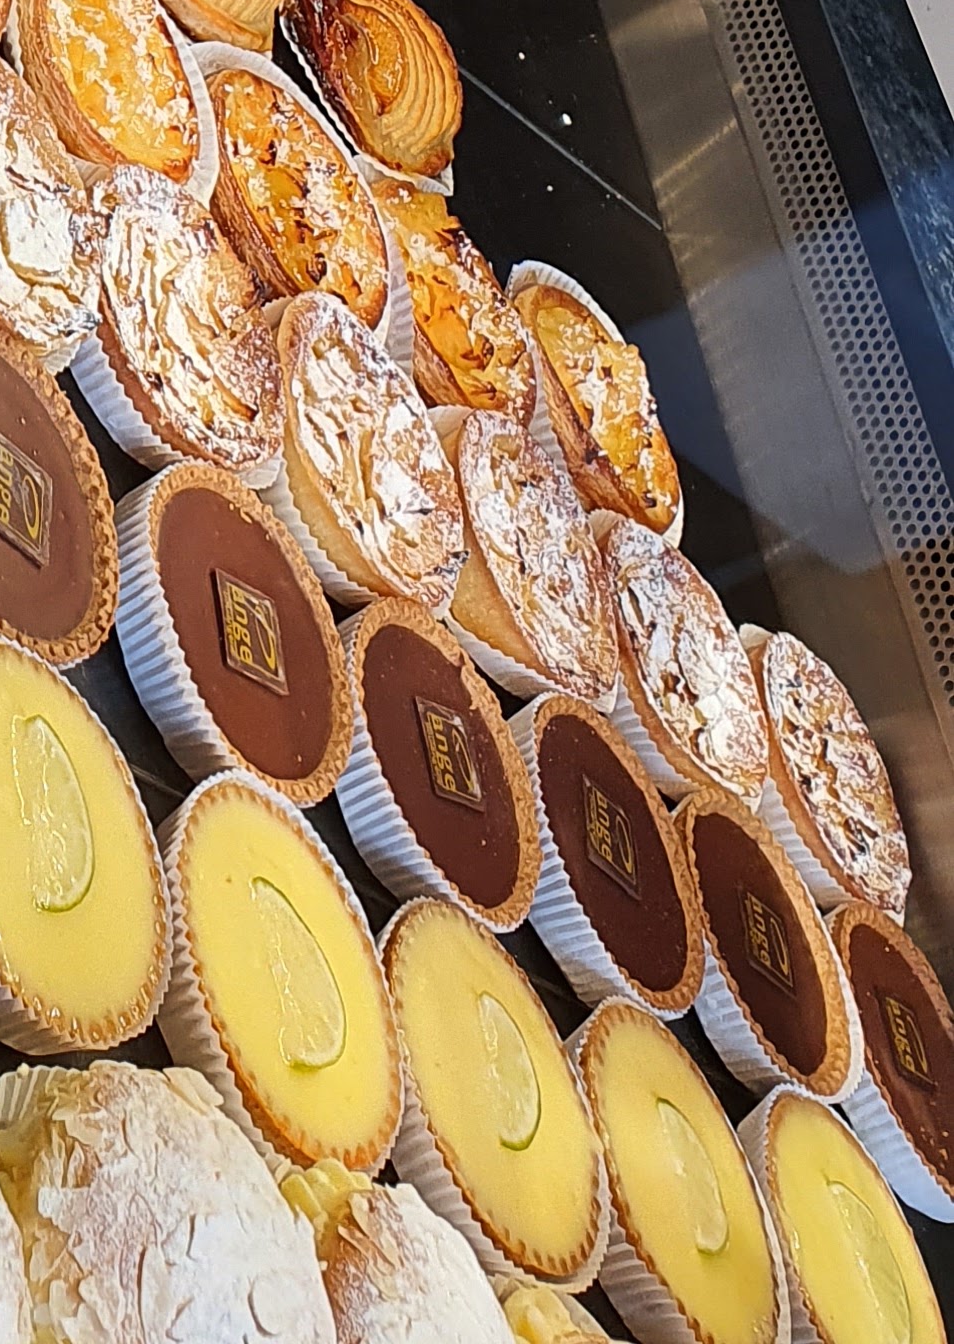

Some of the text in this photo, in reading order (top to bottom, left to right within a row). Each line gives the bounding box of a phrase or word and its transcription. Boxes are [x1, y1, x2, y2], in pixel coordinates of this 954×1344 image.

[232, 585, 253, 664] ange
[432, 715, 456, 791] ange
[595, 792, 613, 862] ange
